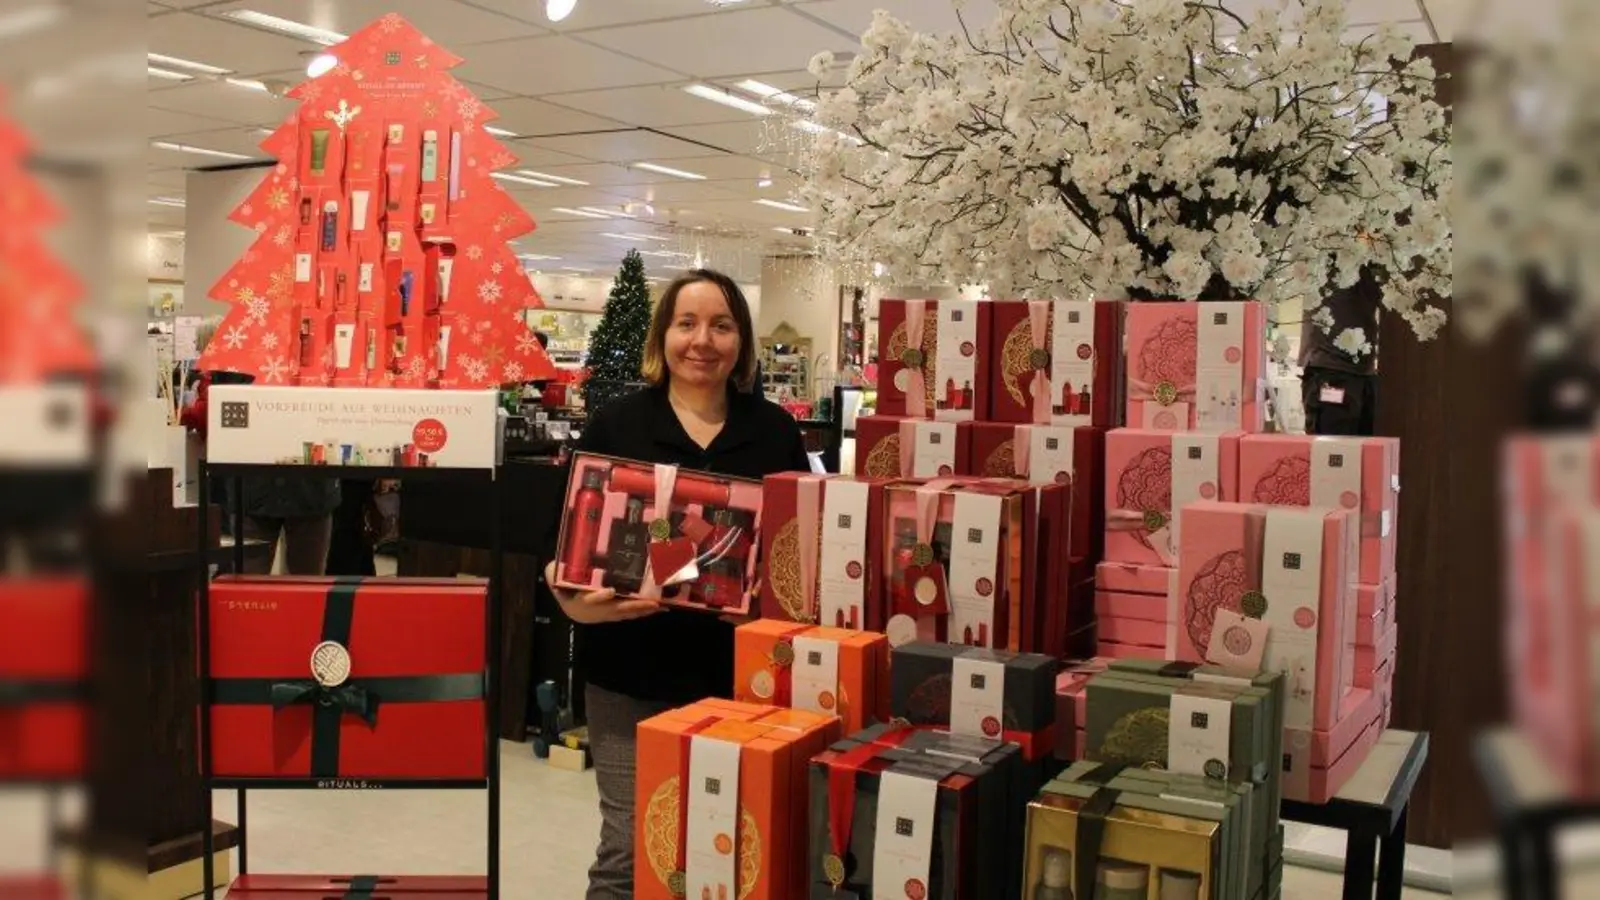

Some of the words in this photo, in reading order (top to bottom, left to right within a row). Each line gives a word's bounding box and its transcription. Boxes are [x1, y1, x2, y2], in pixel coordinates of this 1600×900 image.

[256, 401, 334, 413] VORFREUDE
[341, 403, 366, 414] AUF
[372, 402, 473, 416] WEIHNACHTEN
